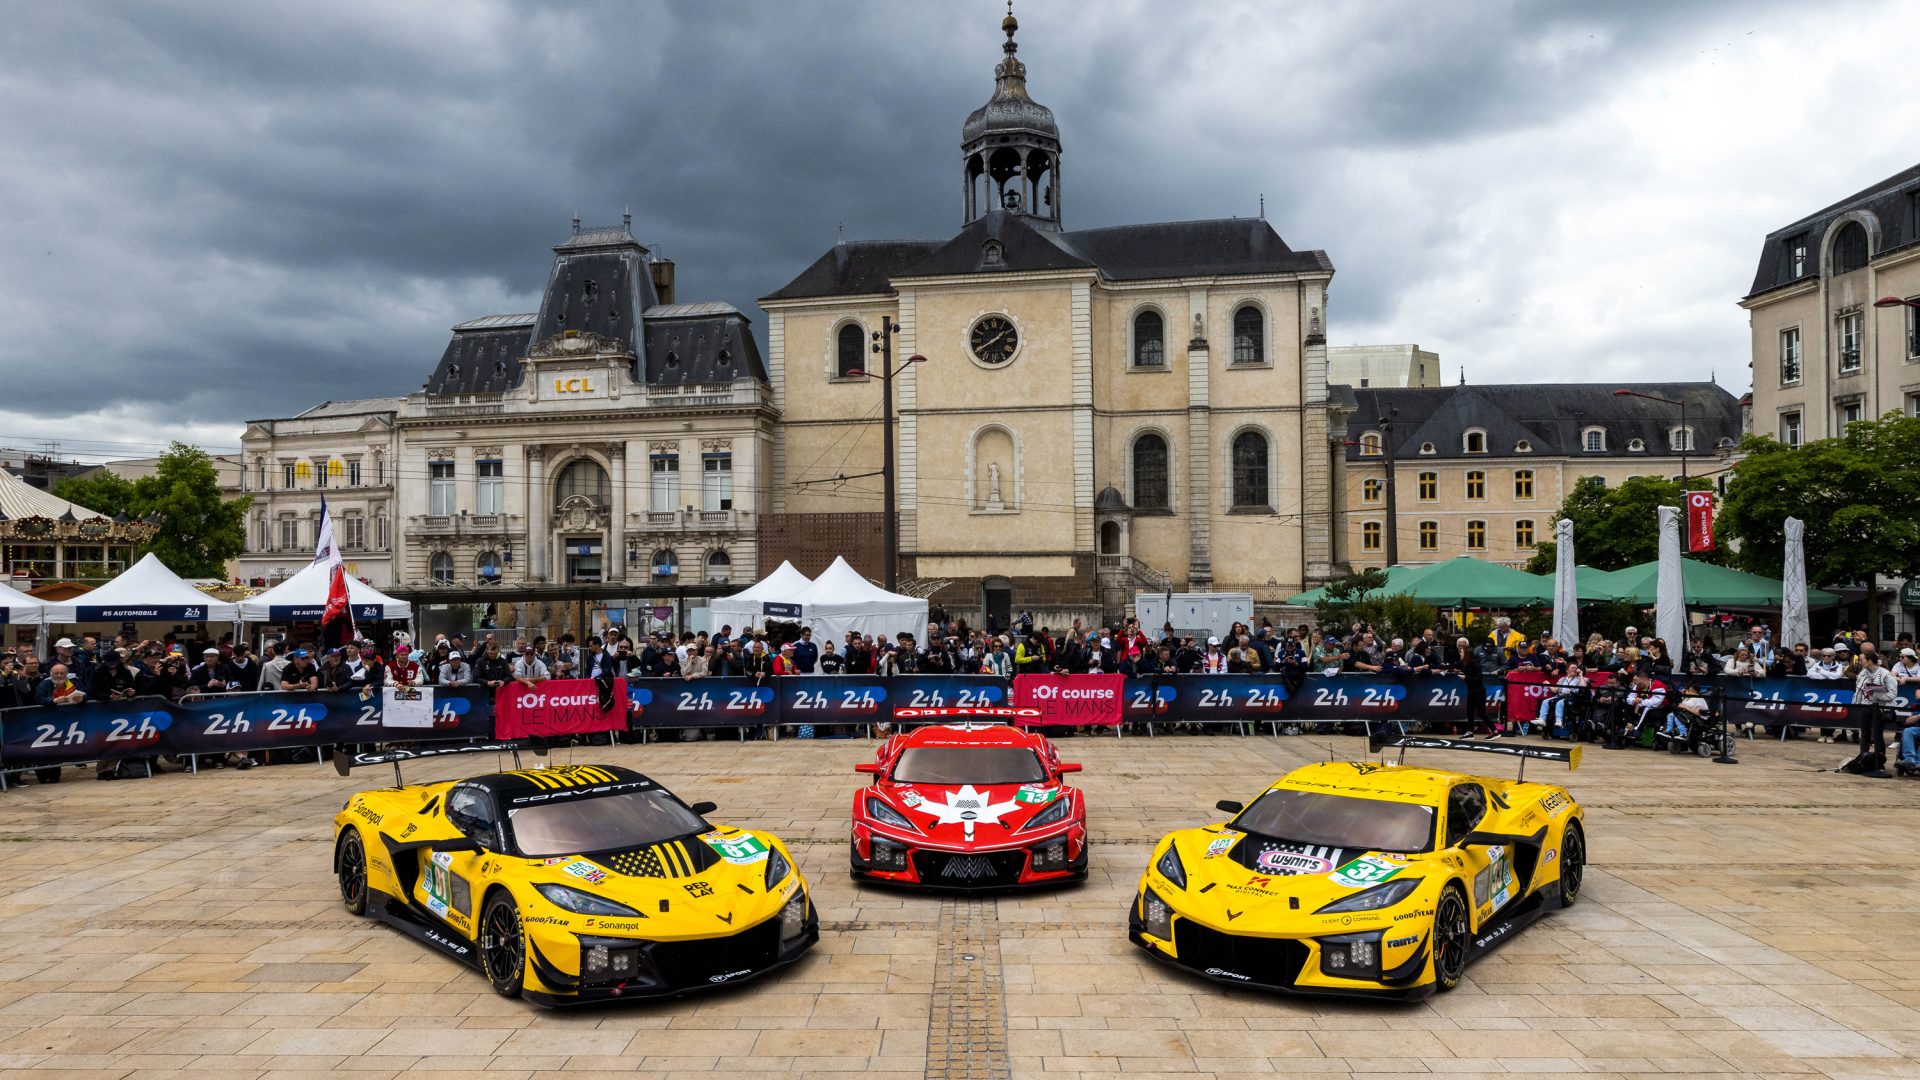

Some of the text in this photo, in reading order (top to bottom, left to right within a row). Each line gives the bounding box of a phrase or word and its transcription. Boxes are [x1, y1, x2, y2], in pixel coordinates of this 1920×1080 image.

[555, 378, 595, 393] LCL
[1032, 685, 1114, 699] :Of course
[517, 694, 599, 708] :Of cours
[1066, 700, 1114, 714] MANS
[522, 709, 544, 725] LE
[513, 781, 649, 803] CORVETTE
[1285, 779, 1428, 799] CORVETTE
[1025, 792, 1049, 803] 13
[354, 802, 384, 826] Sonangol
[722, 841, 758, 858] 81
[567, 862, 586, 871] LM
[573, 864, 597, 876] GT3
[683, 881, 709, 891] REP
[1244, 886, 1279, 896] CONNECT
[690, 887, 714, 898] LAY
[525, 915, 570, 926] GOODYEAR
[1394, 909, 1434, 922] GOODYEAR
[598, 921, 639, 931] Sonangol
[726, 969, 751, 977] SPORT
[1222, 972, 1251, 980] SPORT
